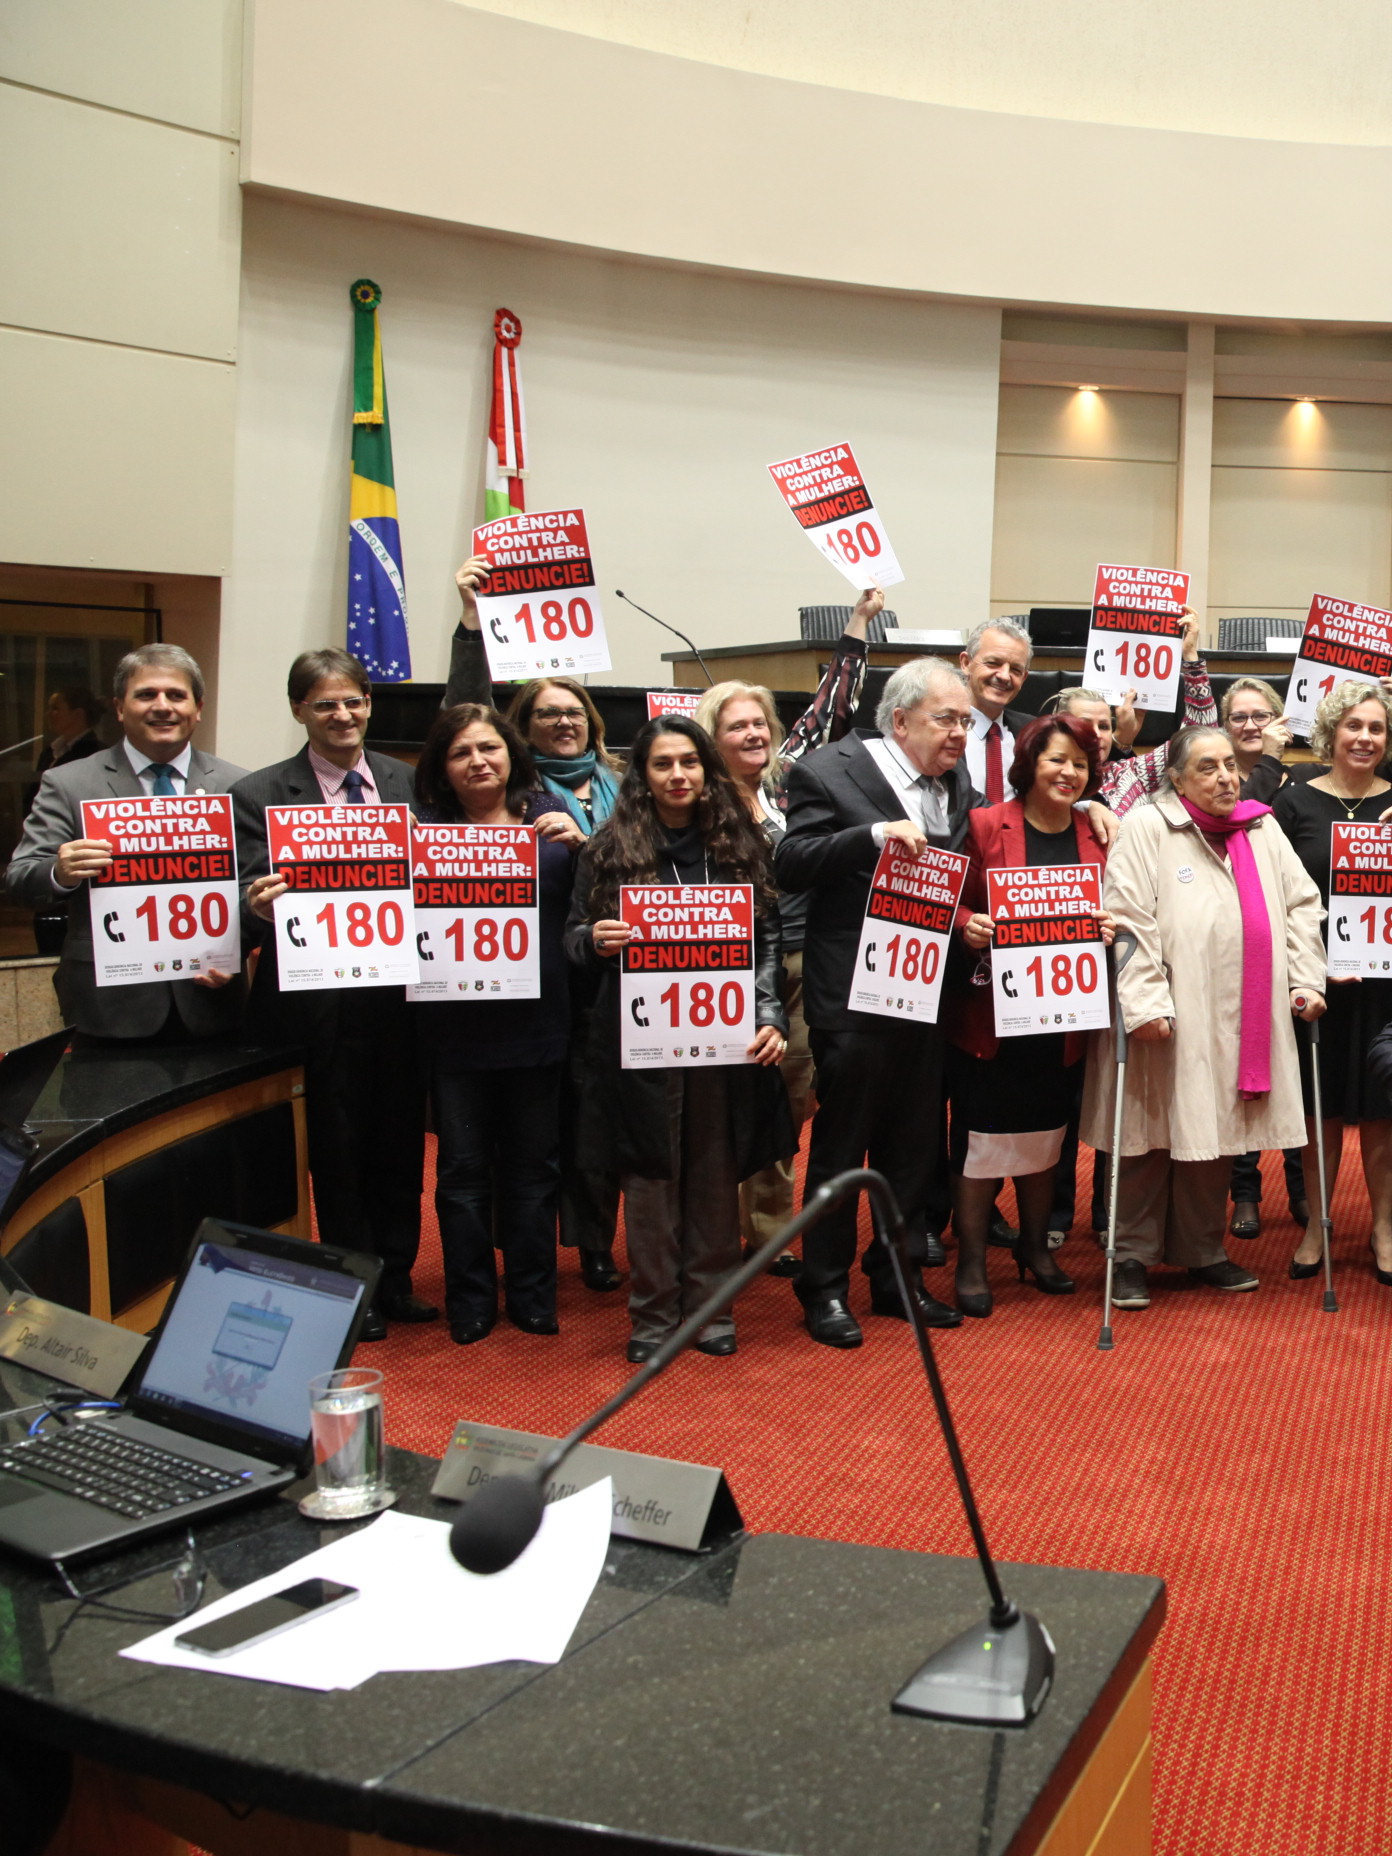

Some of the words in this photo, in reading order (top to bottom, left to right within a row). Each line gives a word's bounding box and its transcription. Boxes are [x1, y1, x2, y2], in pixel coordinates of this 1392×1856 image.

[771, 447, 849, 479] VIOLÊNCIA
[786, 465, 844, 491] CONTRA
[786, 494, 797, 506] A
[795, 475, 859, 503] MULHER:
[794, 489, 869, 527] DENUNCIE!
[477, 513, 580, 541] VIOLÊNCIA
[356, 522, 389, 563] ORDEM
[486, 530, 570, 551] CONTRA
[826, 521, 881, 565] 180
[495, 545, 585, 566] MULHER:
[479, 563, 589, 594] DENUNCIE!
[1102, 568, 1184, 587] VIOLÊNCIA
[1109, 582, 1173, 598] CONTRA
[1098, 594, 1108, 606] A
[1113, 595, 1183, 613] MULHER:
[514, 597, 593, 643] 180
[1095, 610, 1180, 635] DENUNCIE!
[1308, 624, 1320, 636] A
[1322, 613, 1387, 639] CONTRA
[1115, 641, 1173, 680] 180
[1303, 639, 1392, 677] DENUNCIE!
[89, 798, 224, 819] VIOLÊNCIA
[274, 807, 401, 826] VIOLÊNCIA
[108, 818, 211, 836] CONTRA
[292, 827, 388, 842] CONTRA
[413, 826, 531, 844] VIOLÊNCIA
[119, 834, 228, 853] MULHER:
[277, 846, 295, 861] A
[302, 845, 404, 860] MULHER:
[427, 846, 518, 861] CONTRA
[97, 854, 230, 883] DENUNCIE!
[413, 862, 429, 877] A
[434, 862, 533, 877] MULHER:
[891, 860, 949, 886] CONTRA
[1337, 856, 1349, 868] A
[283, 864, 405, 889] DENUNCIE!
[877, 874, 887, 888] A
[891, 878, 955, 904] MULHER:
[993, 868, 1094, 886] VIOLÊNCIA
[413, 882, 533, 904] DENUNCIE!
[628, 887, 746, 905] VIOLÊNCIA
[1007, 885, 1084, 902] CONTRA
[135, 892, 229, 942] 180
[642, 907, 733, 922] CONTRA
[871, 893, 951, 930] DENUNCIE!
[996, 905, 1009, 919] A
[1015, 900, 1096, 918] MULHER:
[316, 900, 405, 949] 180
[631, 925, 645, 940] A
[650, 924, 747, 940] MULHER:
[997, 919, 1099, 945] DENUNCIE!
[445, 917, 529, 962] 180
[628, 944, 748, 969] DENUNCIE!
[886, 934, 939, 985] 180
[1027, 952, 1098, 998] 180
[660, 981, 745, 1028] 180
[41, 1337, 73, 1360] Altair
[70, 1346, 98, 1370] Silva
[612, 1493, 672, 1526] cheffer
